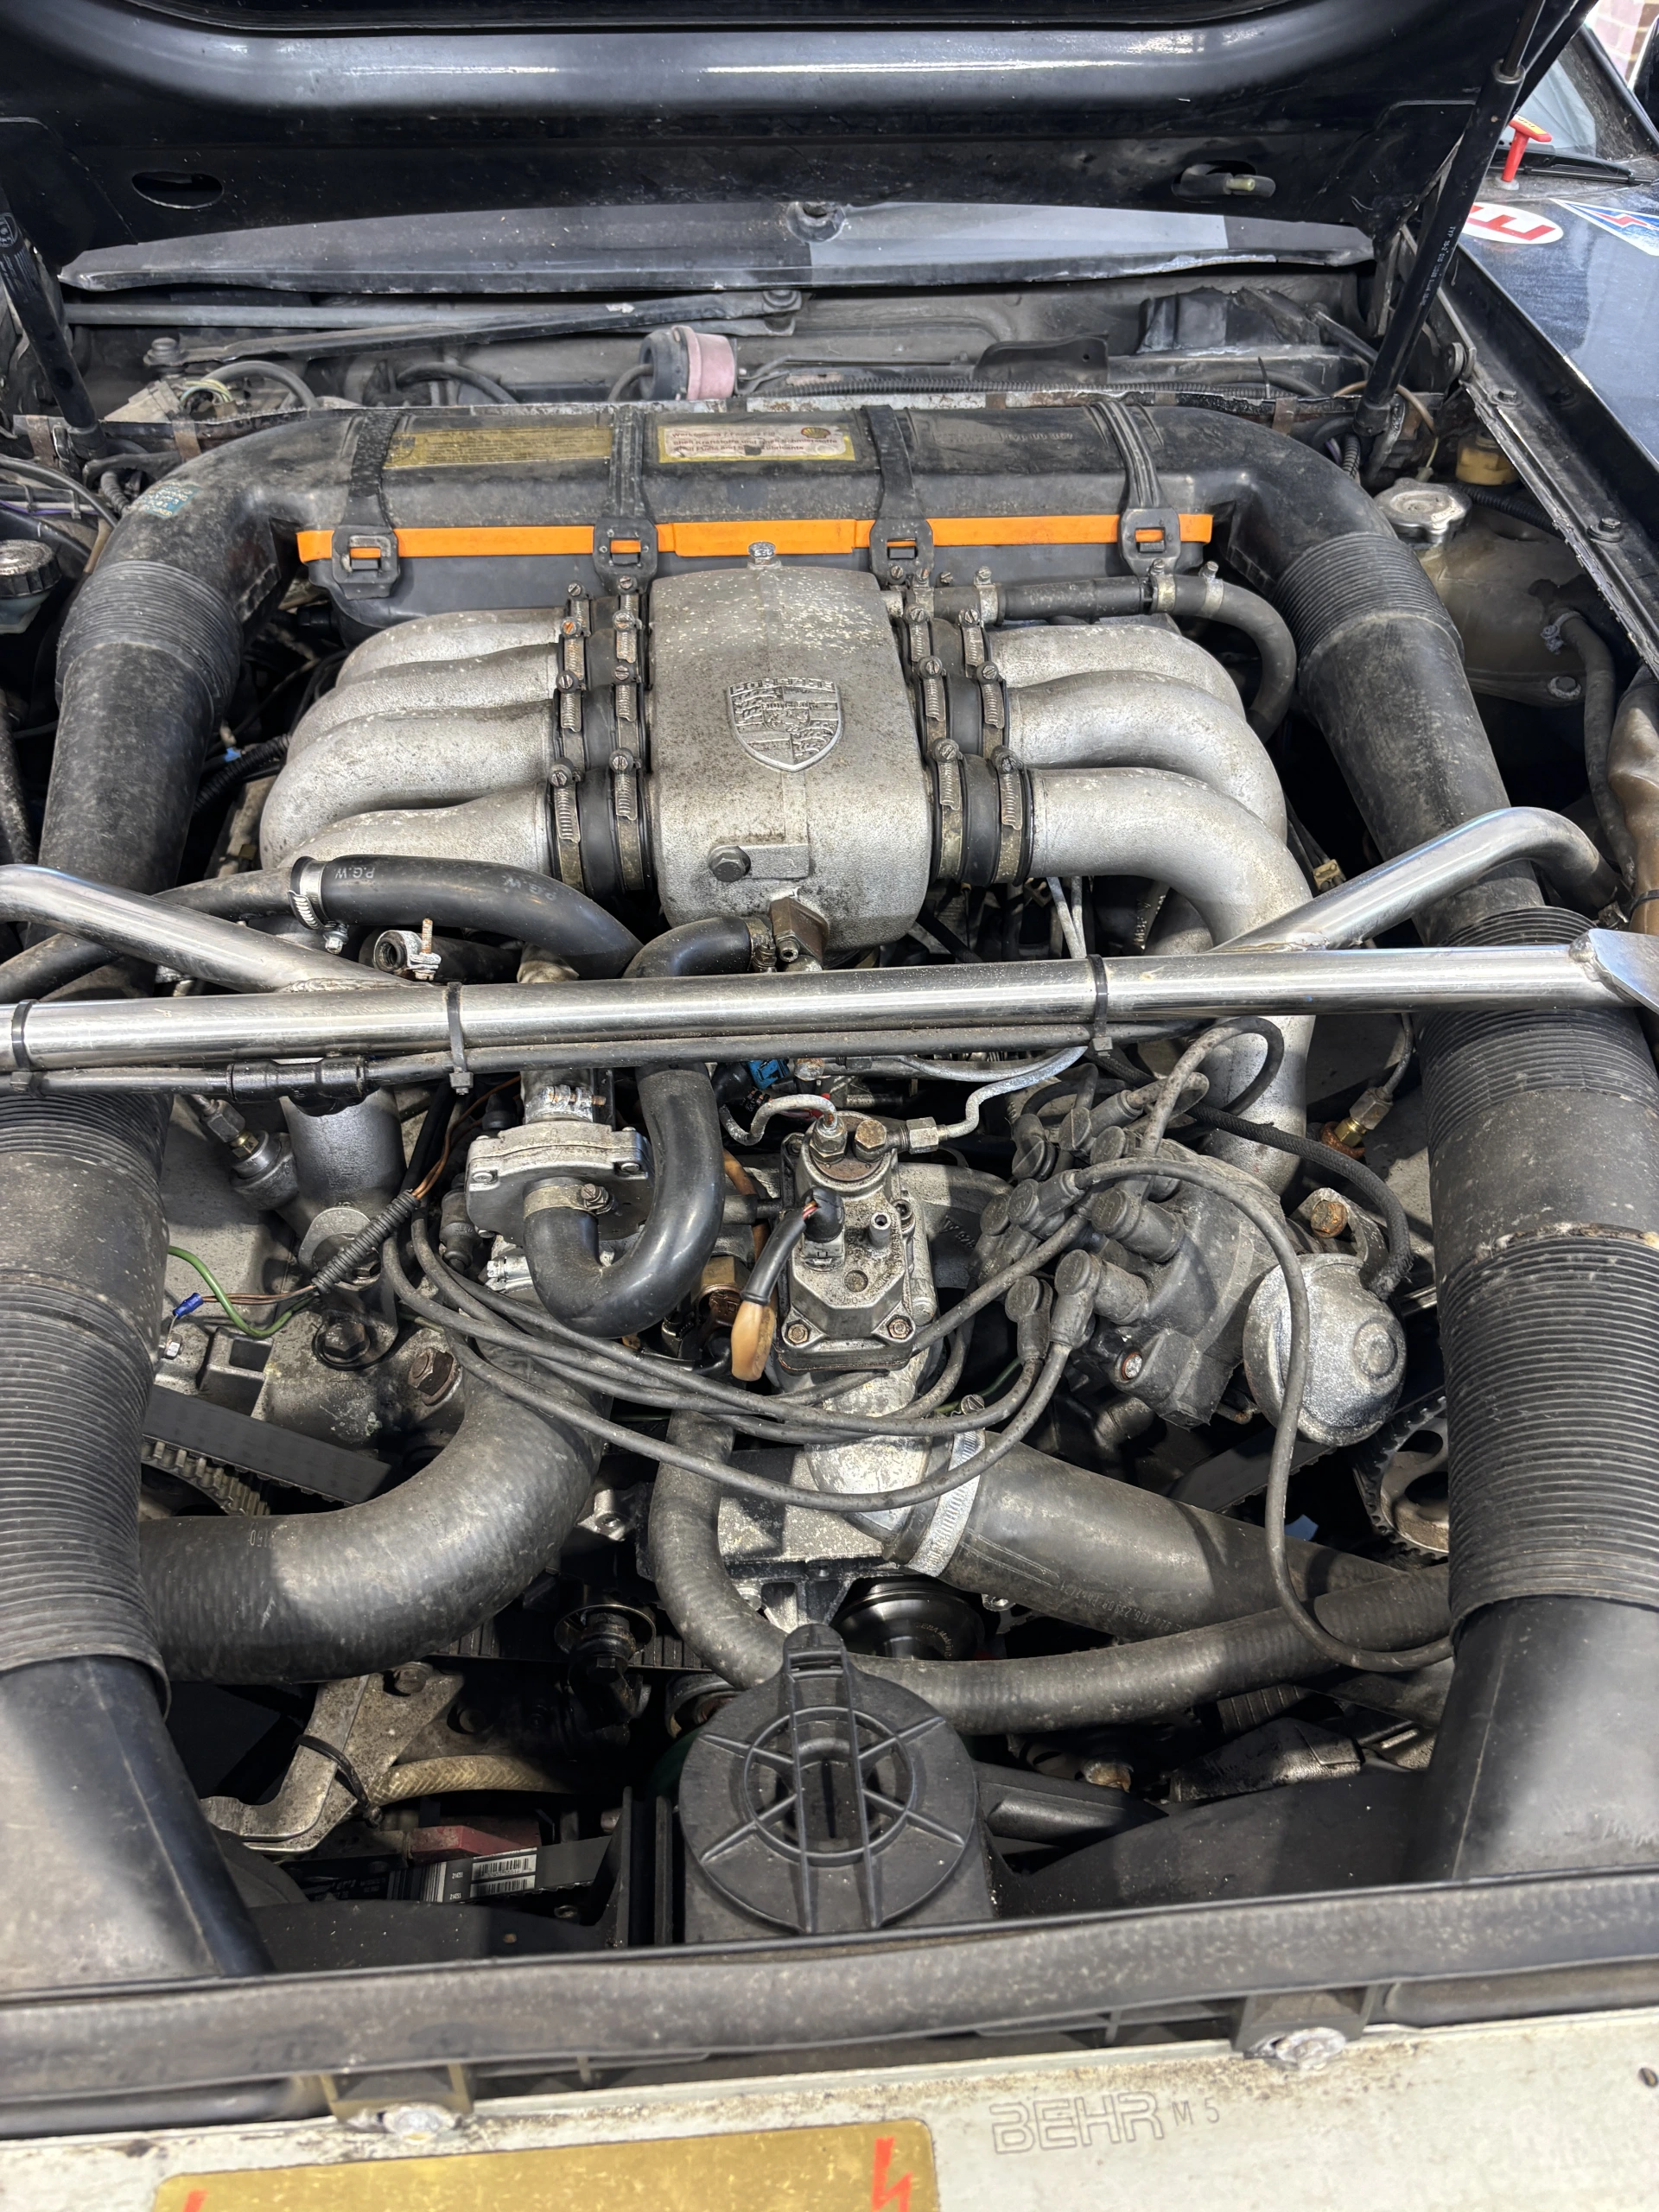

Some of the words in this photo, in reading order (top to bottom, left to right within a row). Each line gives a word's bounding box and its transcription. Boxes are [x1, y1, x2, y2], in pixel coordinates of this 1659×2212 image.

[988, 2091, 1165, 2154] BEHR
[1172, 2100, 1194, 2126] M
[1205, 2097, 1220, 2124] 5
